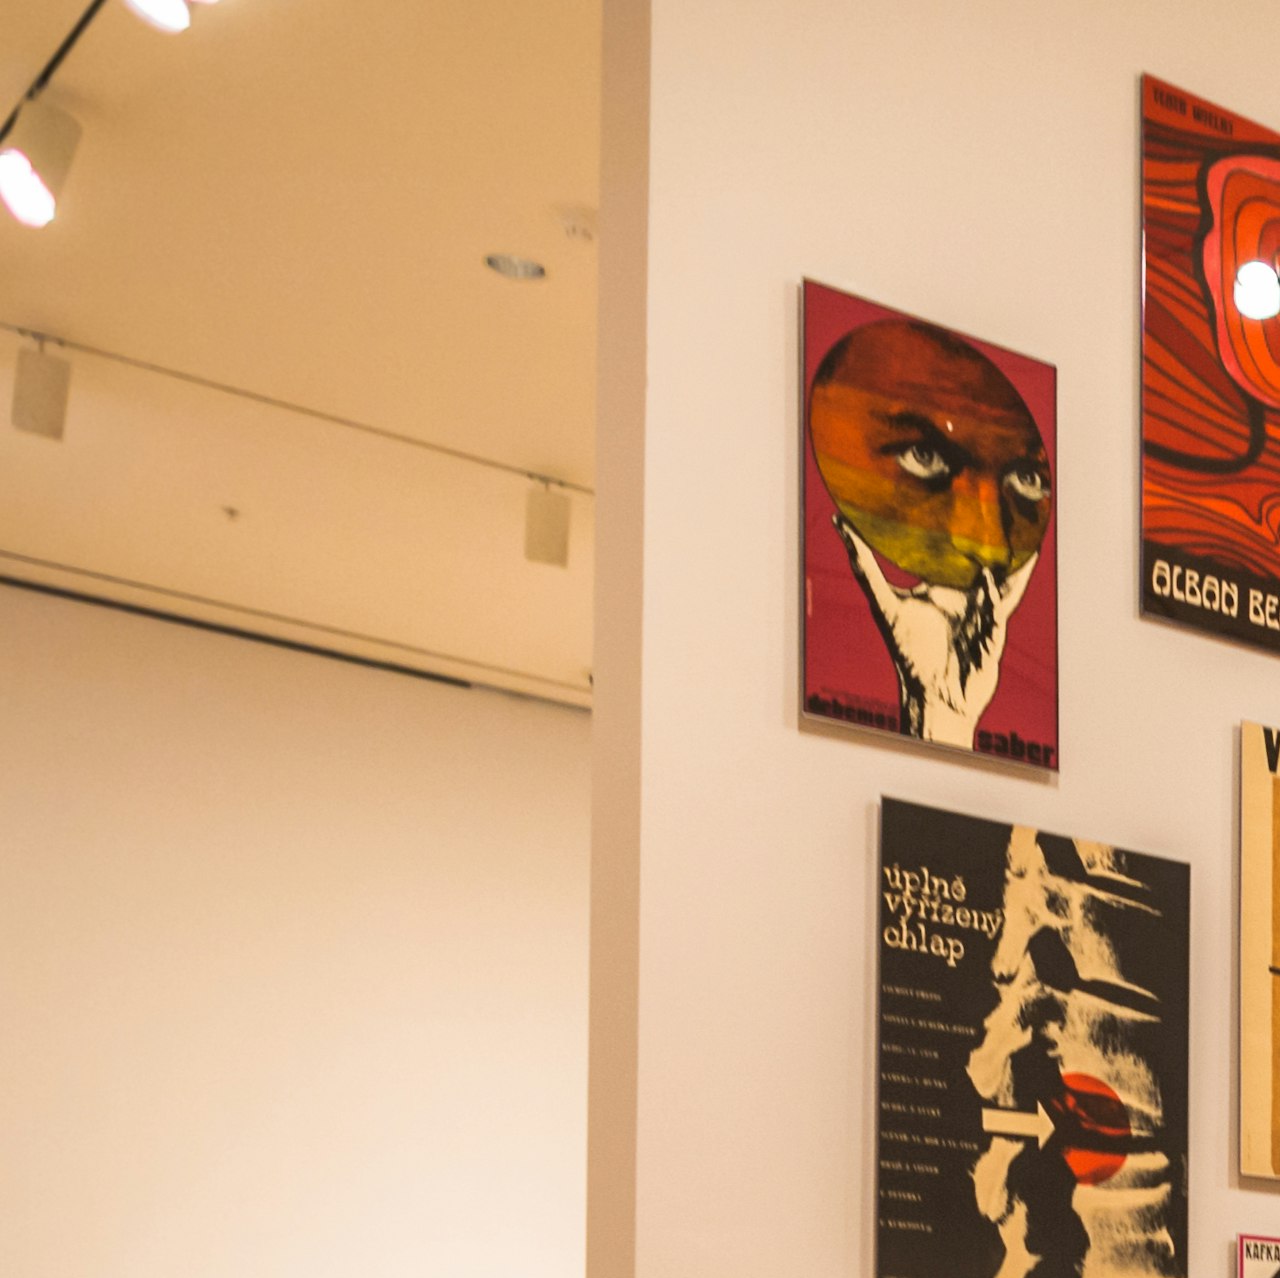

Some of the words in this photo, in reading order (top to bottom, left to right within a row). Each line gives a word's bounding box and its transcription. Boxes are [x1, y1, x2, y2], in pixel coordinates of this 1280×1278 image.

[1152, 559, 1239, 618] ALBAN
[977, 730, 1055, 767] saber
[883, 915, 965, 968] chlap
[1245, 1241, 1280, 1263] KAFKA
